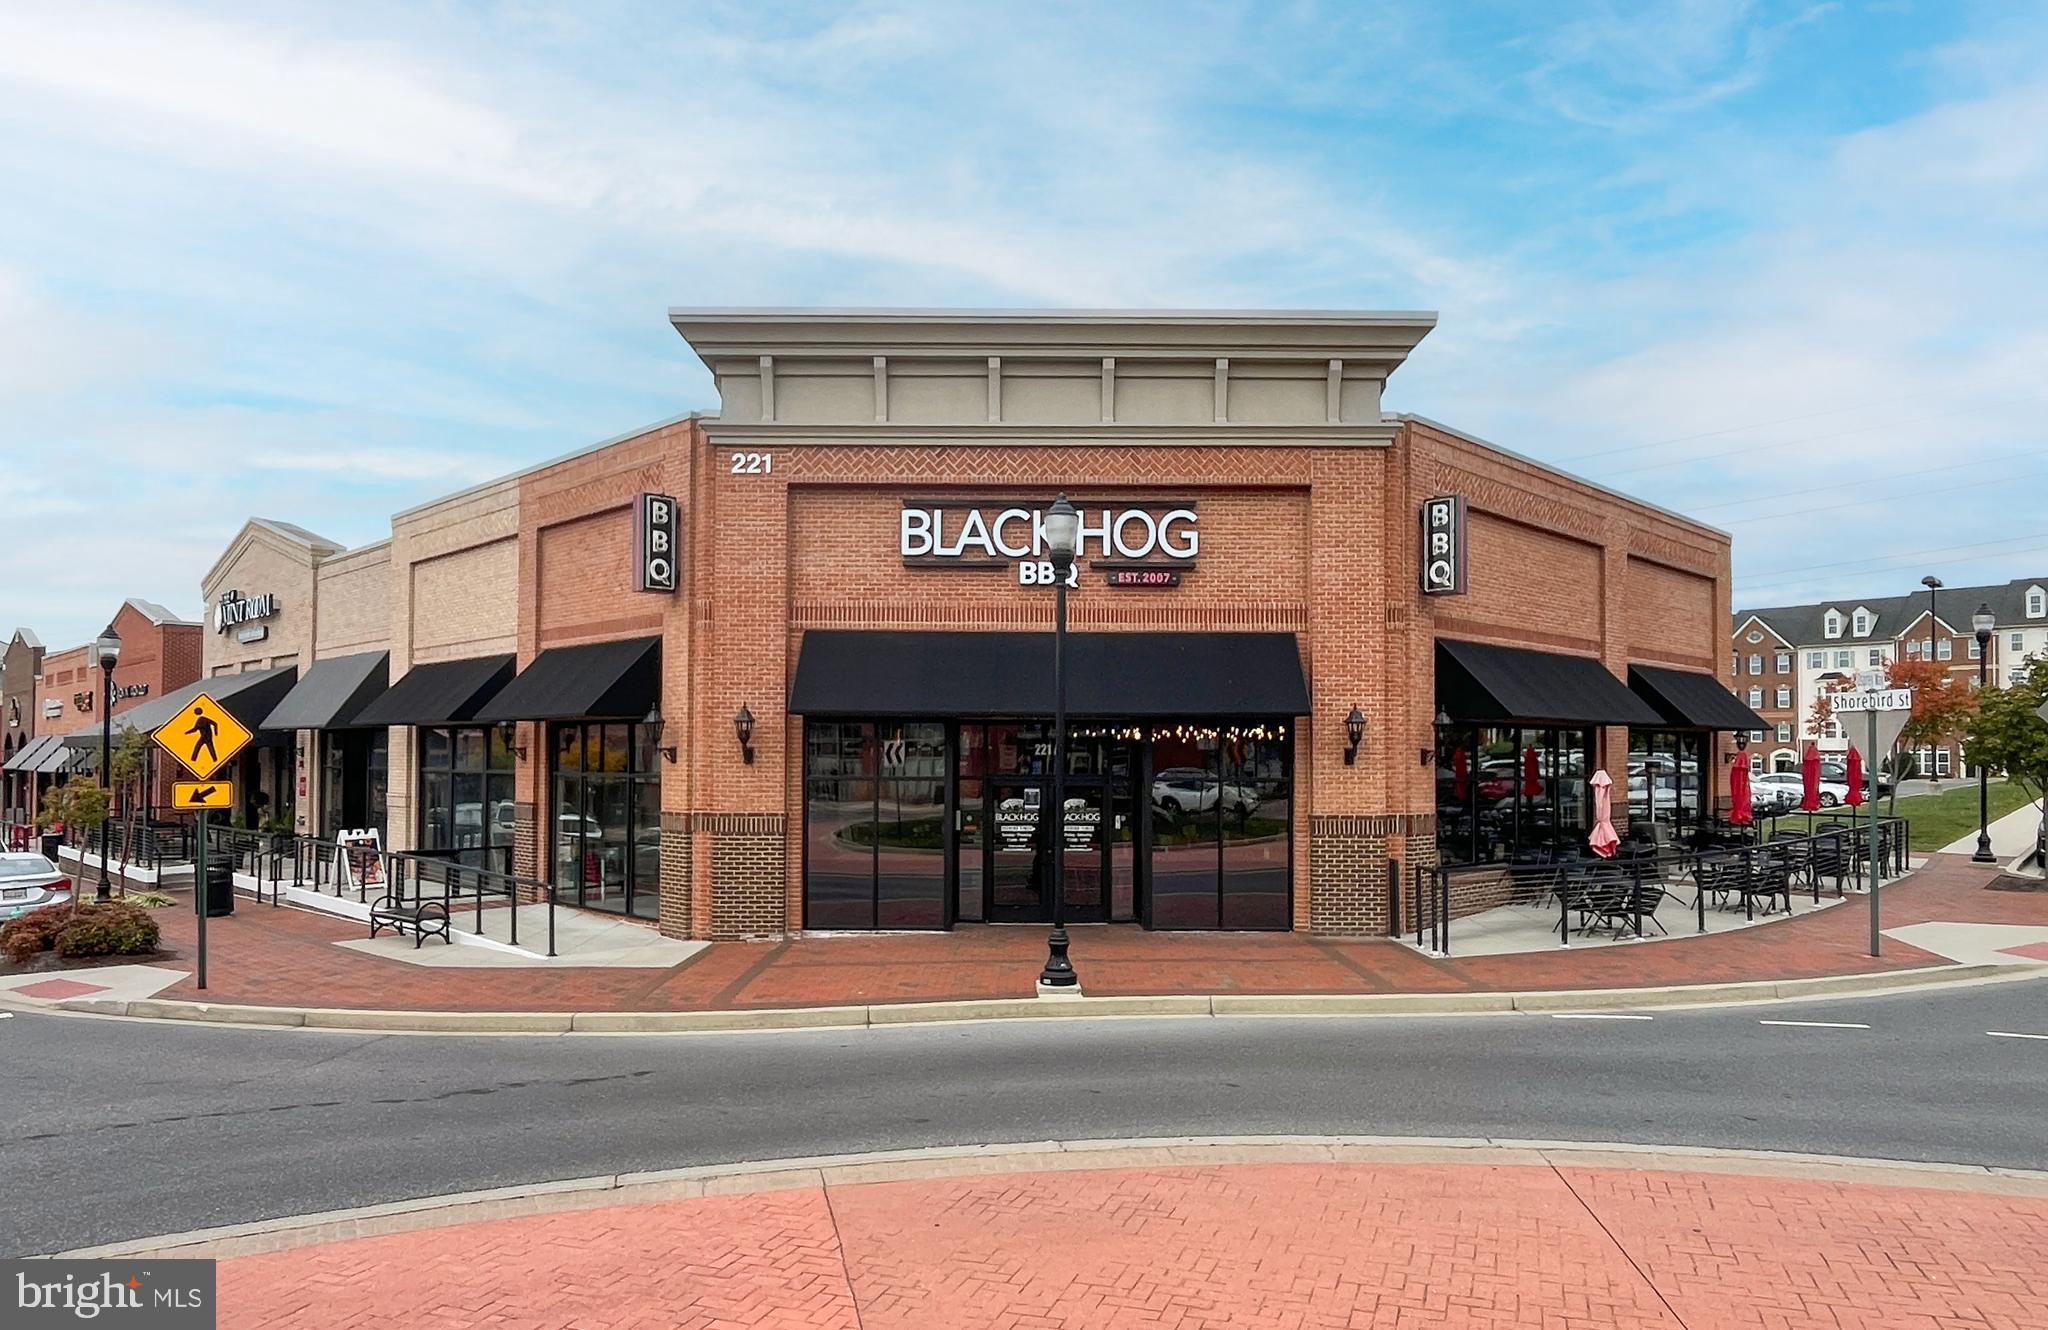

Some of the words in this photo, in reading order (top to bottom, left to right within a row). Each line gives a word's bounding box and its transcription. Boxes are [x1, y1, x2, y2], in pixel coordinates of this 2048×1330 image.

[731, 453, 772, 474] 221
[650, 500, 671, 586] BBQ
[901, 508, 1049, 558] BLACK
[1076, 509, 1199, 559] HOG
[1429, 503, 1452, 586] BBQ
[1118, 572, 1141, 583] EST.
[1142, 572, 1171, 583] 2007
[1833, 692, 1894, 710] Shorebird
[1898, 693, 1909, 707] St
[1020, 813, 1039, 821] HOG
[1063, 813, 1081, 821] ACK
[1081, 813, 1101, 821] HOG
